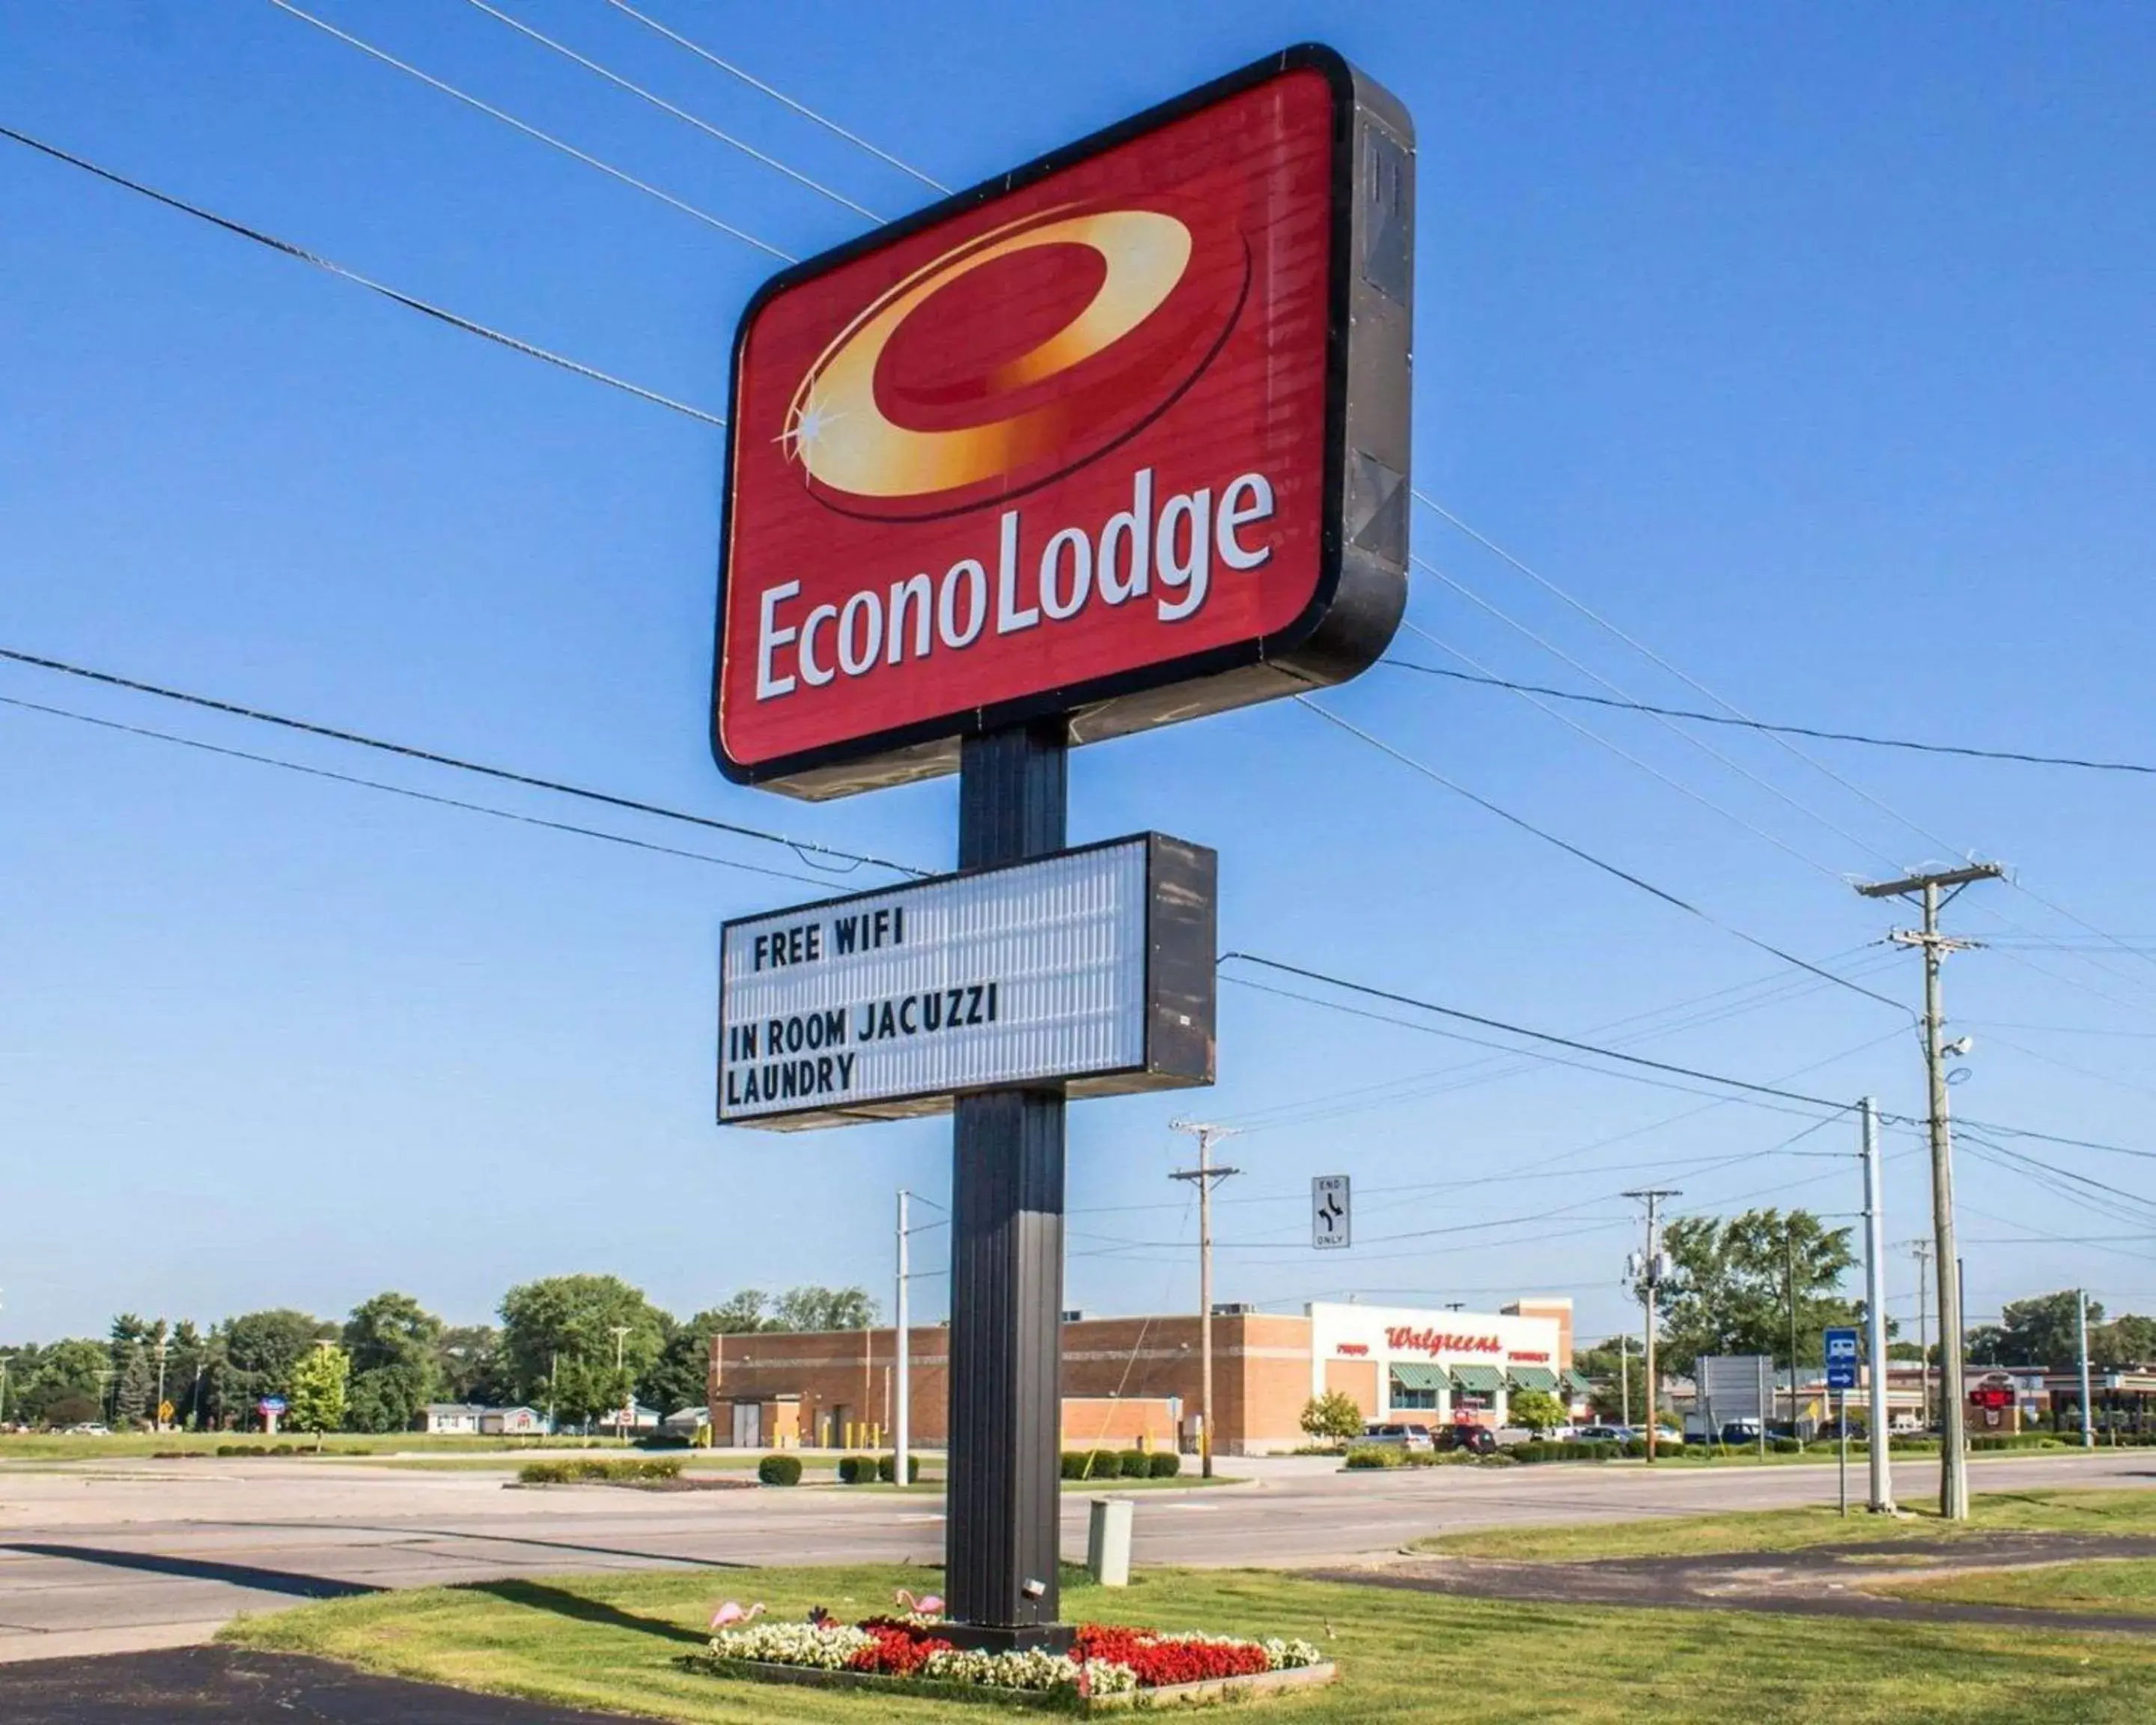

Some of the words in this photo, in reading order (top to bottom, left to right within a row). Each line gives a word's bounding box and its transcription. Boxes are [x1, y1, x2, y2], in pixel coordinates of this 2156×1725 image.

[755, 468, 1274, 701] EconoLodge
[755, 924, 820, 971] FREE
[835, 907, 903, 954] WIFI
[731, 1025, 758, 1062] IN
[769, 1008, 846, 1053] ROOM
[859, 983, 998, 1041] JACUZZI
[728, 1053, 855, 1106] LAUNDRY
[1318, 1235, 1342, 1245] ONLY
[1385, 1326, 1502, 1357] Walgreens
